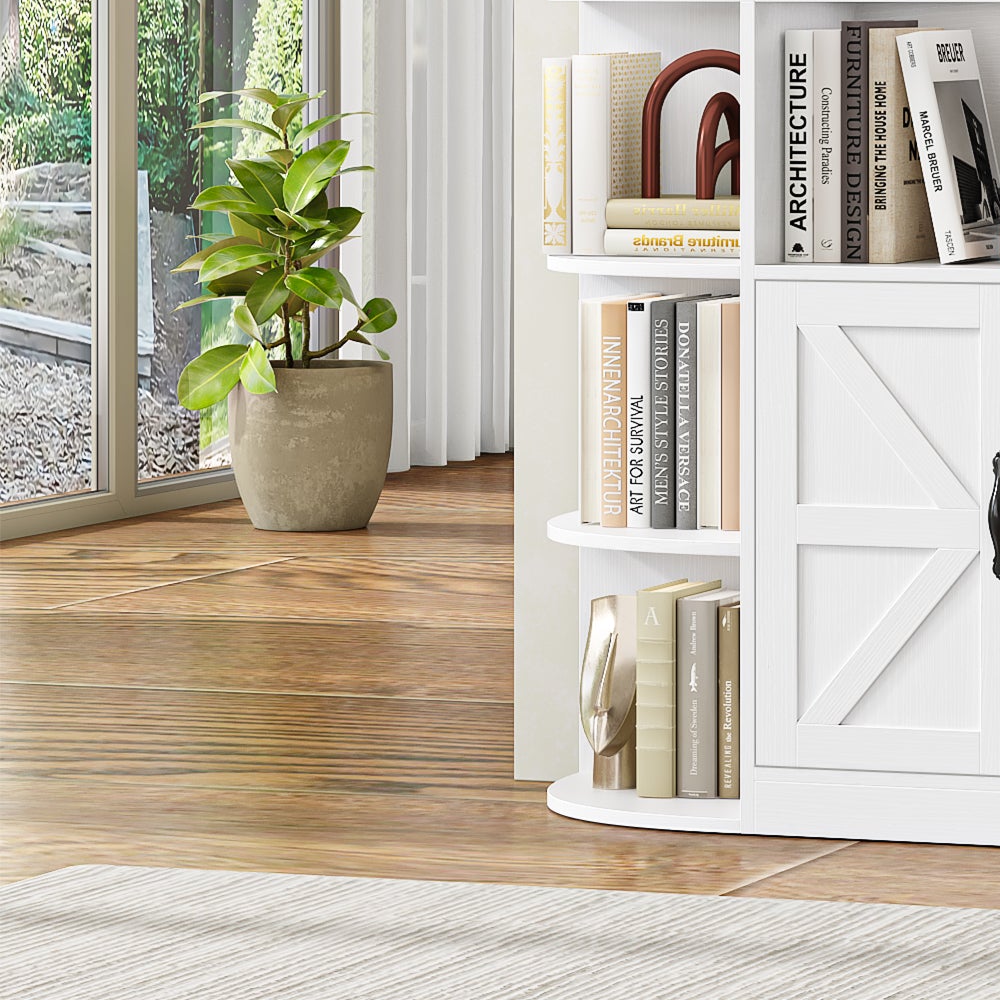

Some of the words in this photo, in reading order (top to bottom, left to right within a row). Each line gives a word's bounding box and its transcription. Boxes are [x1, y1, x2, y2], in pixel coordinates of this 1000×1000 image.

[936, 42, 965, 63] BREUER
[818, 87, 833, 145] Constructing
[846, 26, 862, 165] FURNITURE
[874, 81, 887, 107] HOME
[789, 53, 807, 231] ARCHITECTURE
[874, 107, 887, 141] HOUSE
[874, 143, 887, 163] THE
[918, 110, 934, 151] MARCEL
[927, 153, 943, 192] BREUER
[874, 165, 887, 210] BRINGING
[846, 173, 862, 261] DESIGN
[654, 319, 669, 391] STORIES
[678, 321, 690, 428] DONATELLA
[602, 336, 621, 515] INNENARCHITEKTUR
[630, 395, 644, 455] SURVIVAL
[654, 394, 669, 449] STYLE
[630, 459, 643, 486] FOR
[654, 452, 669, 505] MEN'S
[678, 431, 690, 512] VERSACE
[630, 492, 643, 514] ART
[644, 606, 660, 626] A
[689, 699, 698, 727] Sweden
[723, 680, 732, 730] Revolution
[689, 728, 698, 739] of
[724, 732, 732, 743] the
[689, 741, 698, 776] Dreaming
[724, 744, 732, 789] REVEALING
